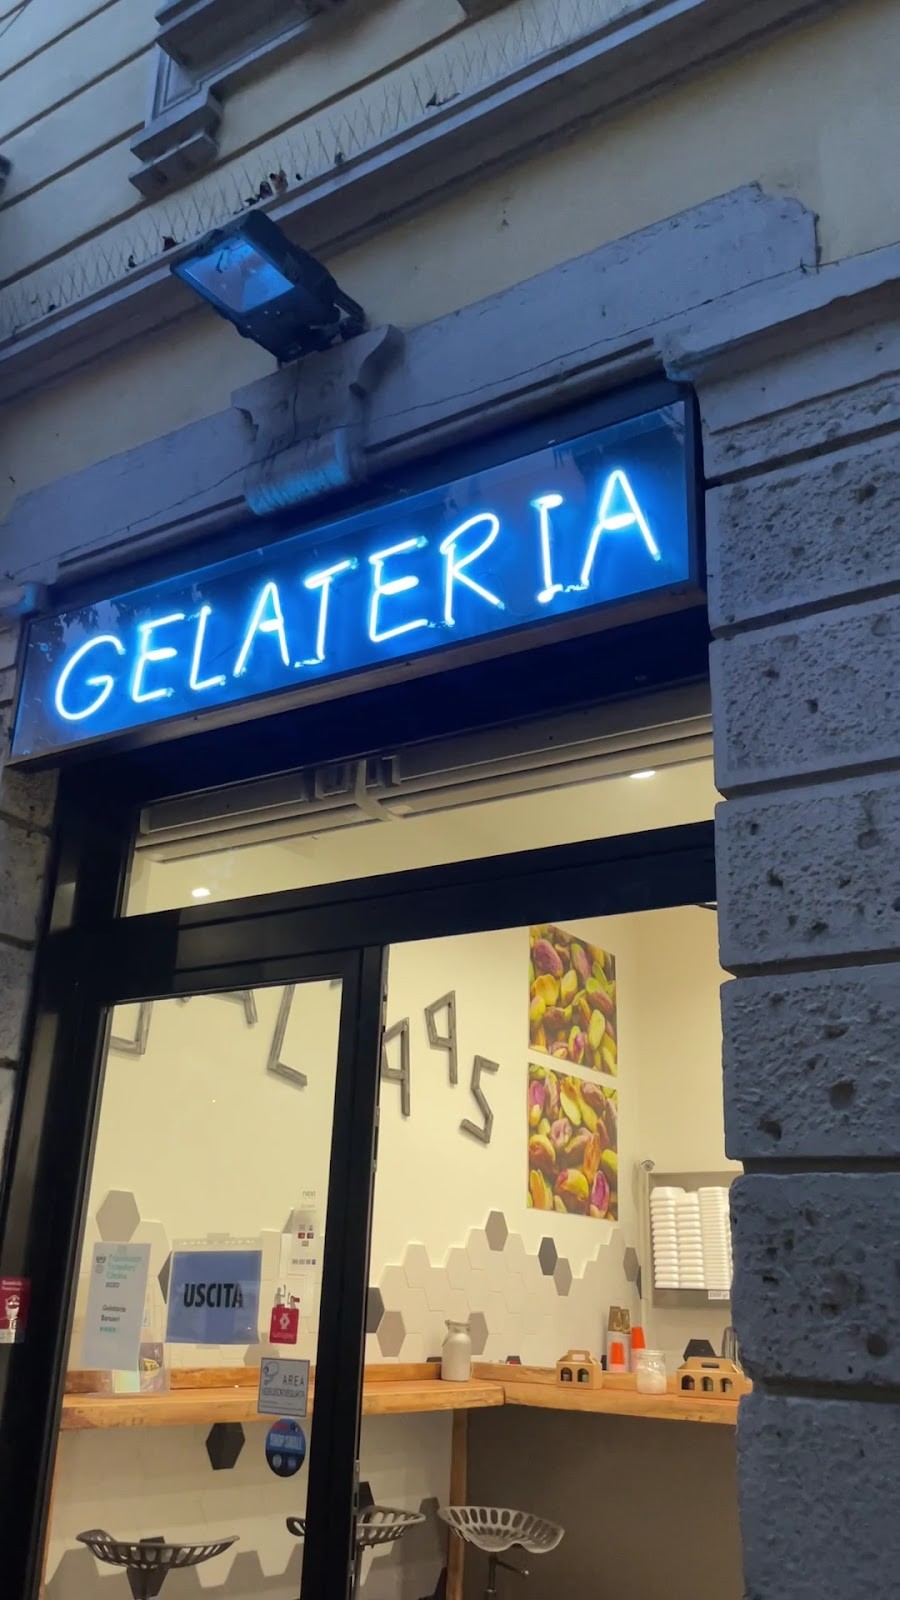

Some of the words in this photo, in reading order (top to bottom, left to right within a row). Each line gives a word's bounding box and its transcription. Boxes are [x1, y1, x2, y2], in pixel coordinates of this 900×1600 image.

[55, 469, 662, 721] GELATERIA
[183, 1283, 244, 1308] USCITA
[282, 1374, 304, 1387] AREA
